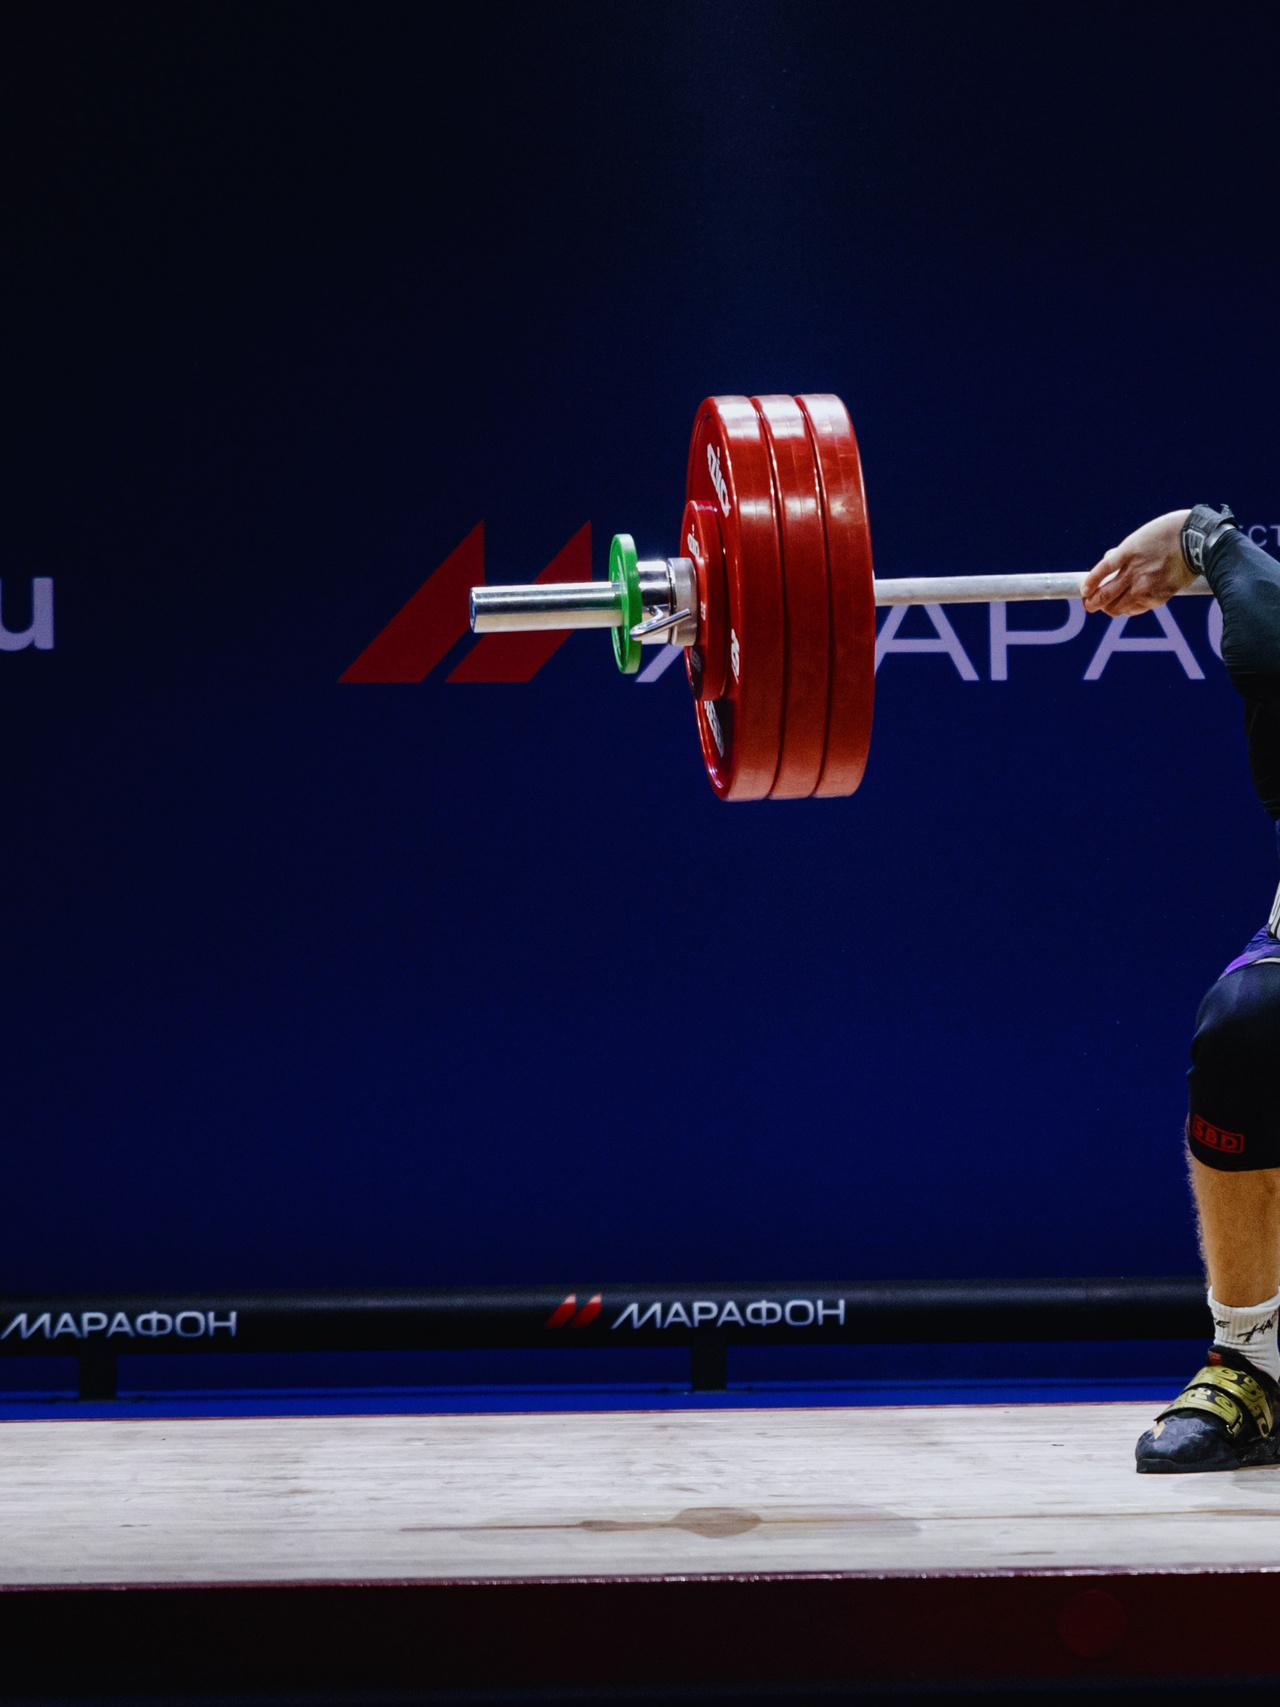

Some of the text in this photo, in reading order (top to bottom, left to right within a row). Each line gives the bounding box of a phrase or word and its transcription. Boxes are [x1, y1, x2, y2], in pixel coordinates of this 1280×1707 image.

[1195, 1120, 1239, 1151] SBD
[1, 1310, 239, 1340] МАРАФОН
[610, 1298, 847, 1330] МАРАФОН
